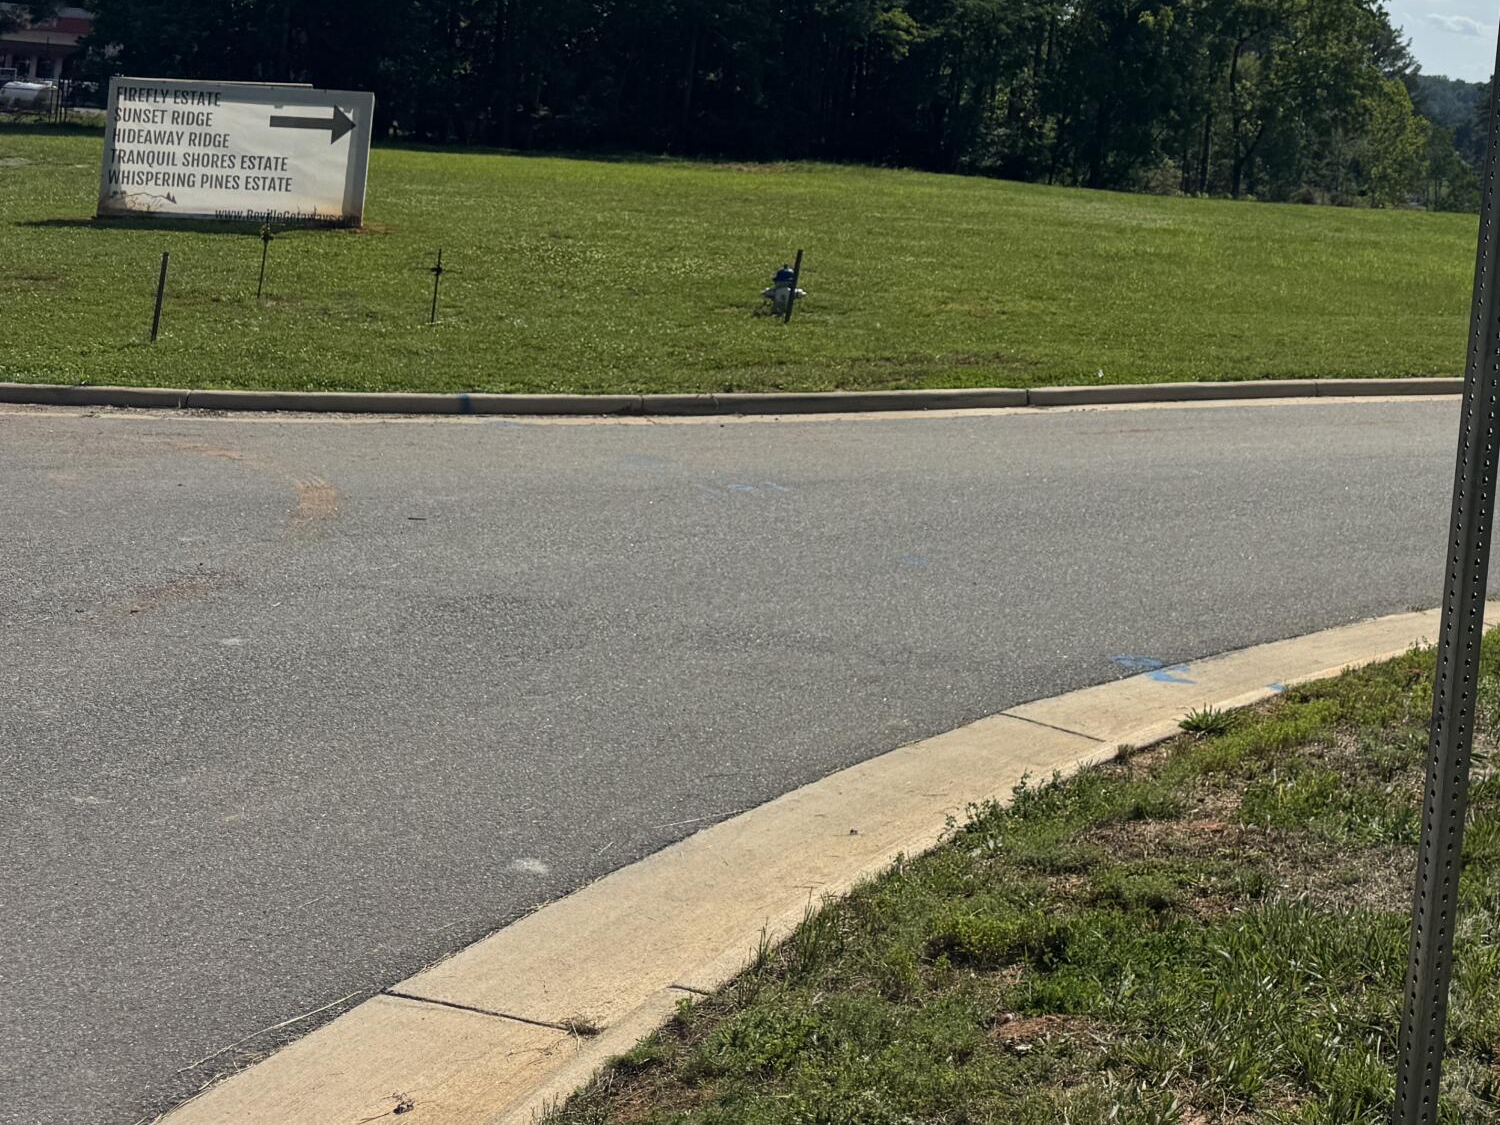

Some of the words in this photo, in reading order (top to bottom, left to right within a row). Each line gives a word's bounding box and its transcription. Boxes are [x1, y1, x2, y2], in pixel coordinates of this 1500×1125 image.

[116, 86, 169, 103] FIREFLY
[173, 89, 222, 107] ESTATE
[114, 106, 168, 125] SUNSET
[171, 110, 213, 127] RIDGE
[112, 127, 185, 146] HIDEAWAY
[188, 131, 231, 149] RIDGE
[110, 148, 177, 168] TRANQUIL
[182, 152, 236, 169] SHORES
[240, 154, 289, 172] ESTATE
[108, 169, 196, 188] WHISPERING
[200, 173, 240, 190] PINES
[245, 175, 293, 192] ESTATE
